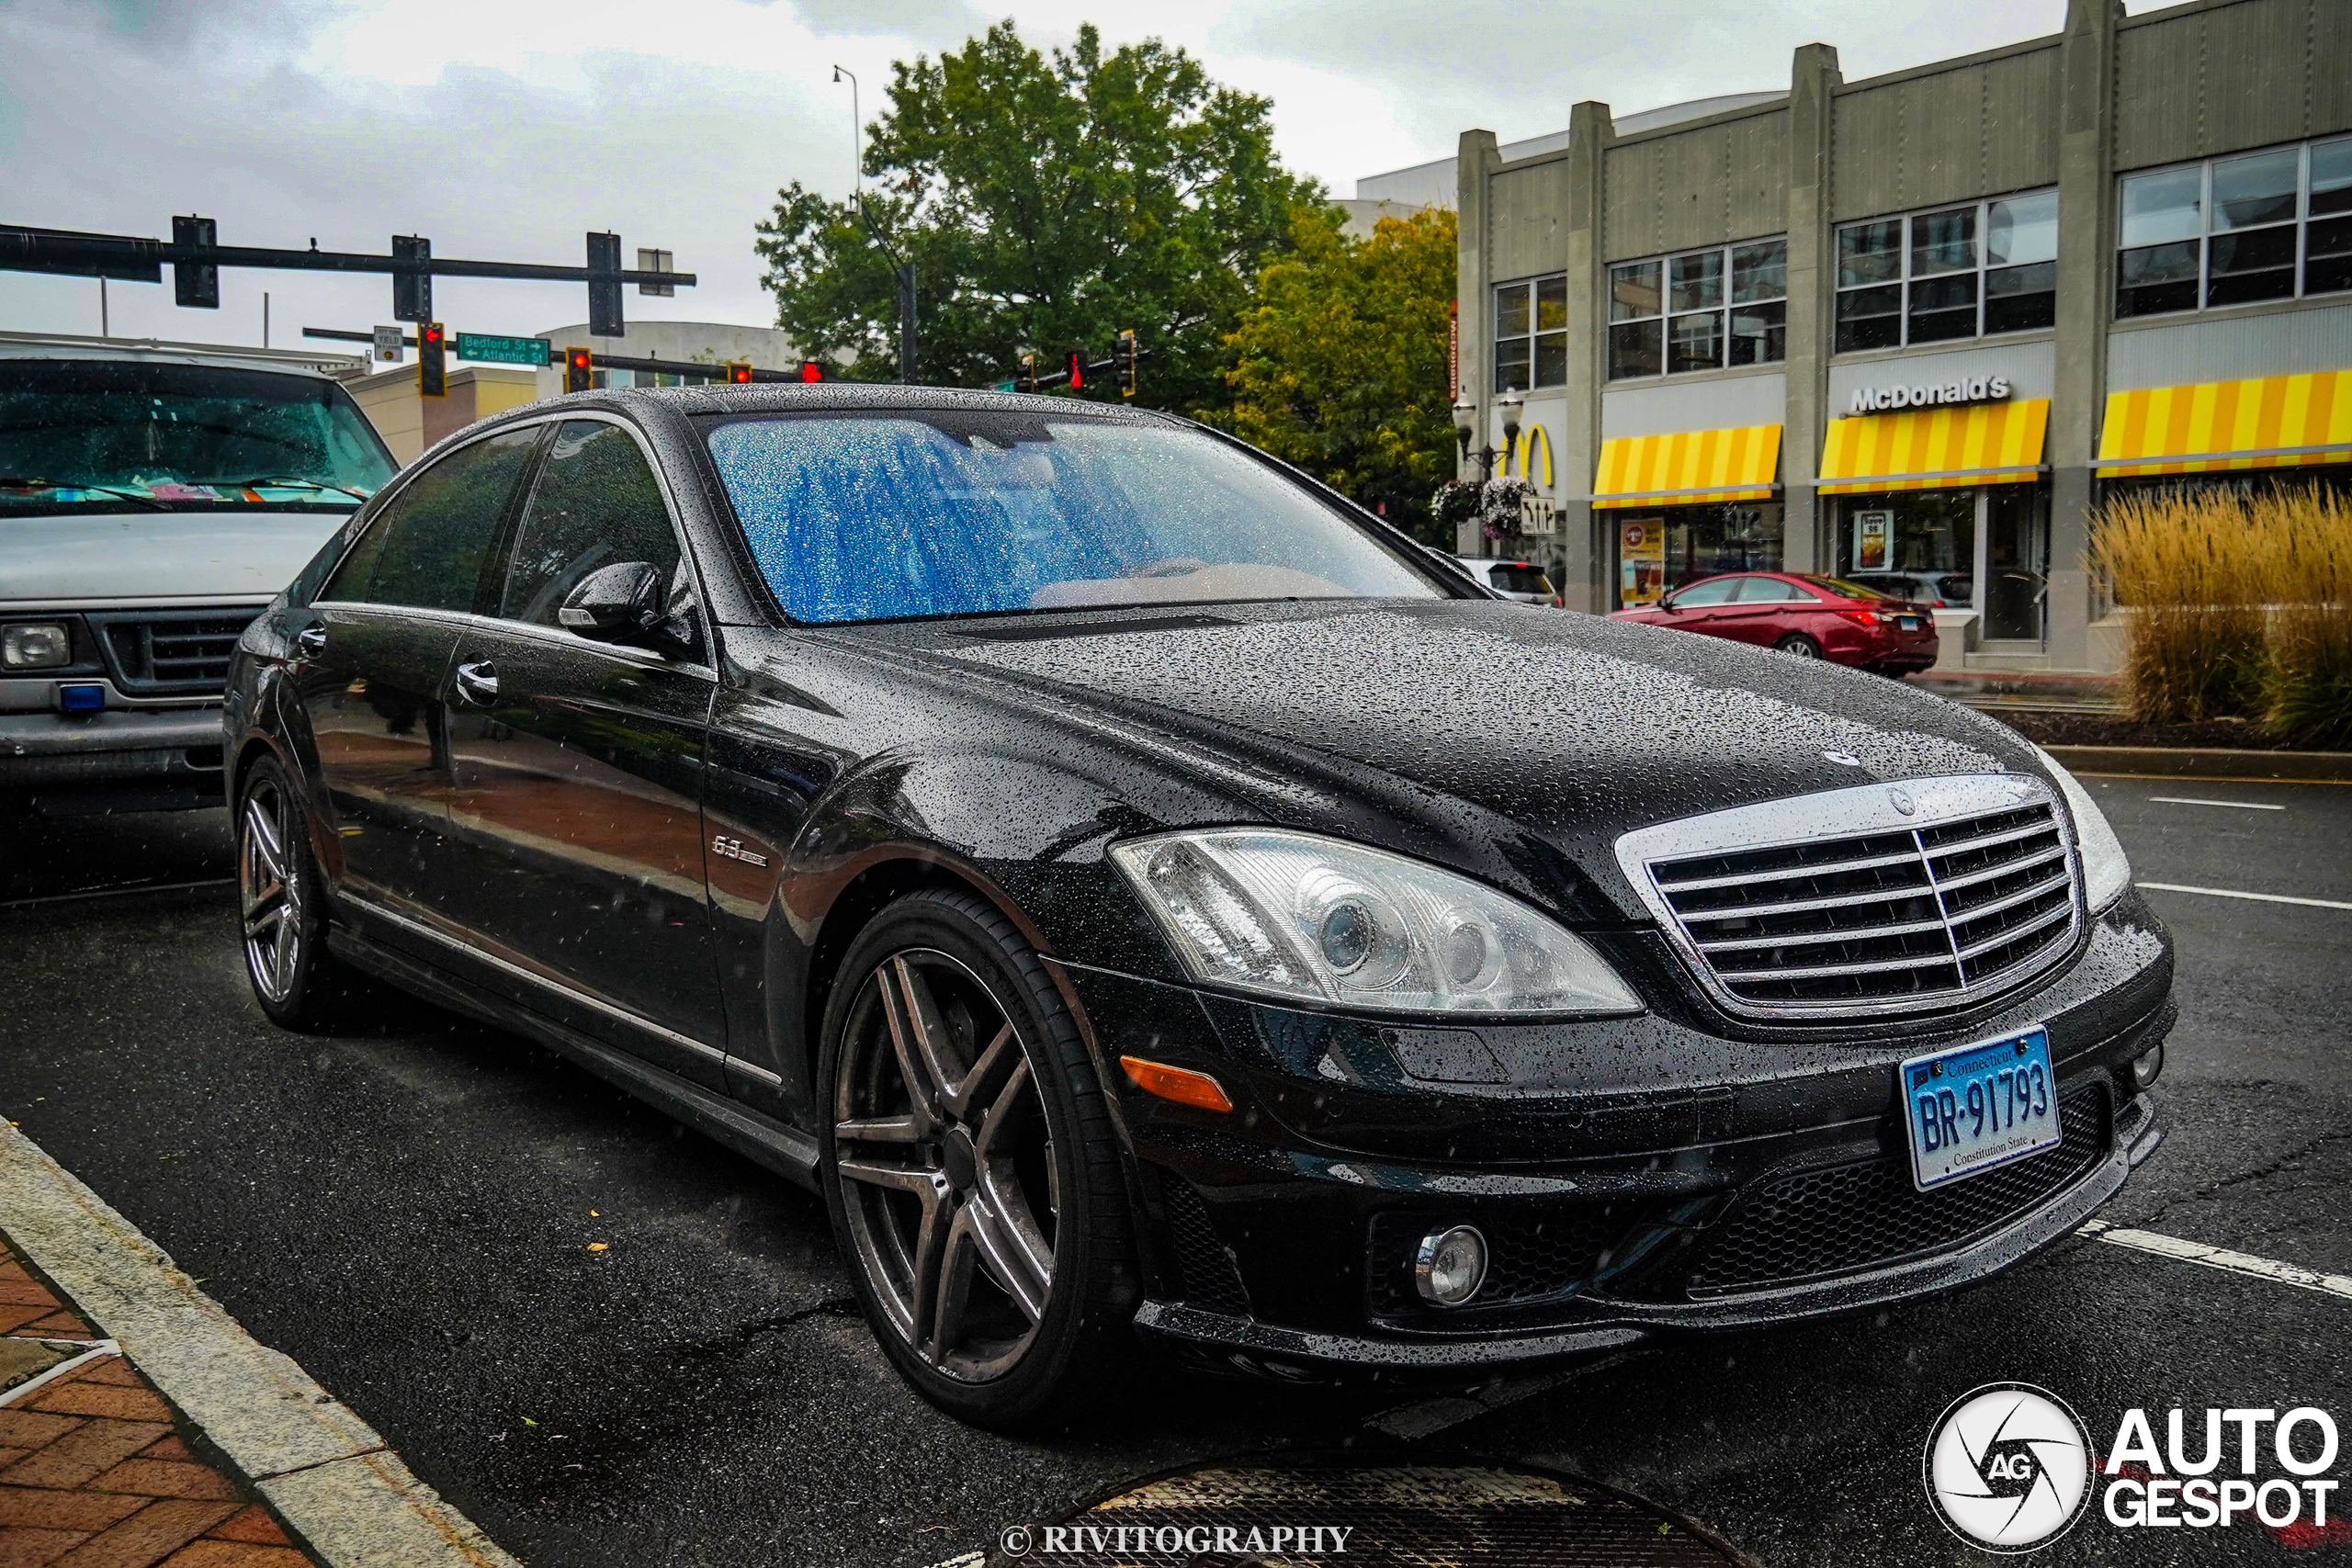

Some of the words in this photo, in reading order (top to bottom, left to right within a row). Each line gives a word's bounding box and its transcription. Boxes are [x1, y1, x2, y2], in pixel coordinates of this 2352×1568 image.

[465, 336, 510, 350] Bedford
[514, 341, 526, 351] St
[482, 349, 526, 362] Atlantic
[531, 352, 543, 364] St
[1850, 376, 2010, 412] McDonald's
[1947, 1050, 2013, 1078] Connecticut
[1953, 1145, 2007, 1167] Constitution
[2007, 1135, 2028, 1150] State
